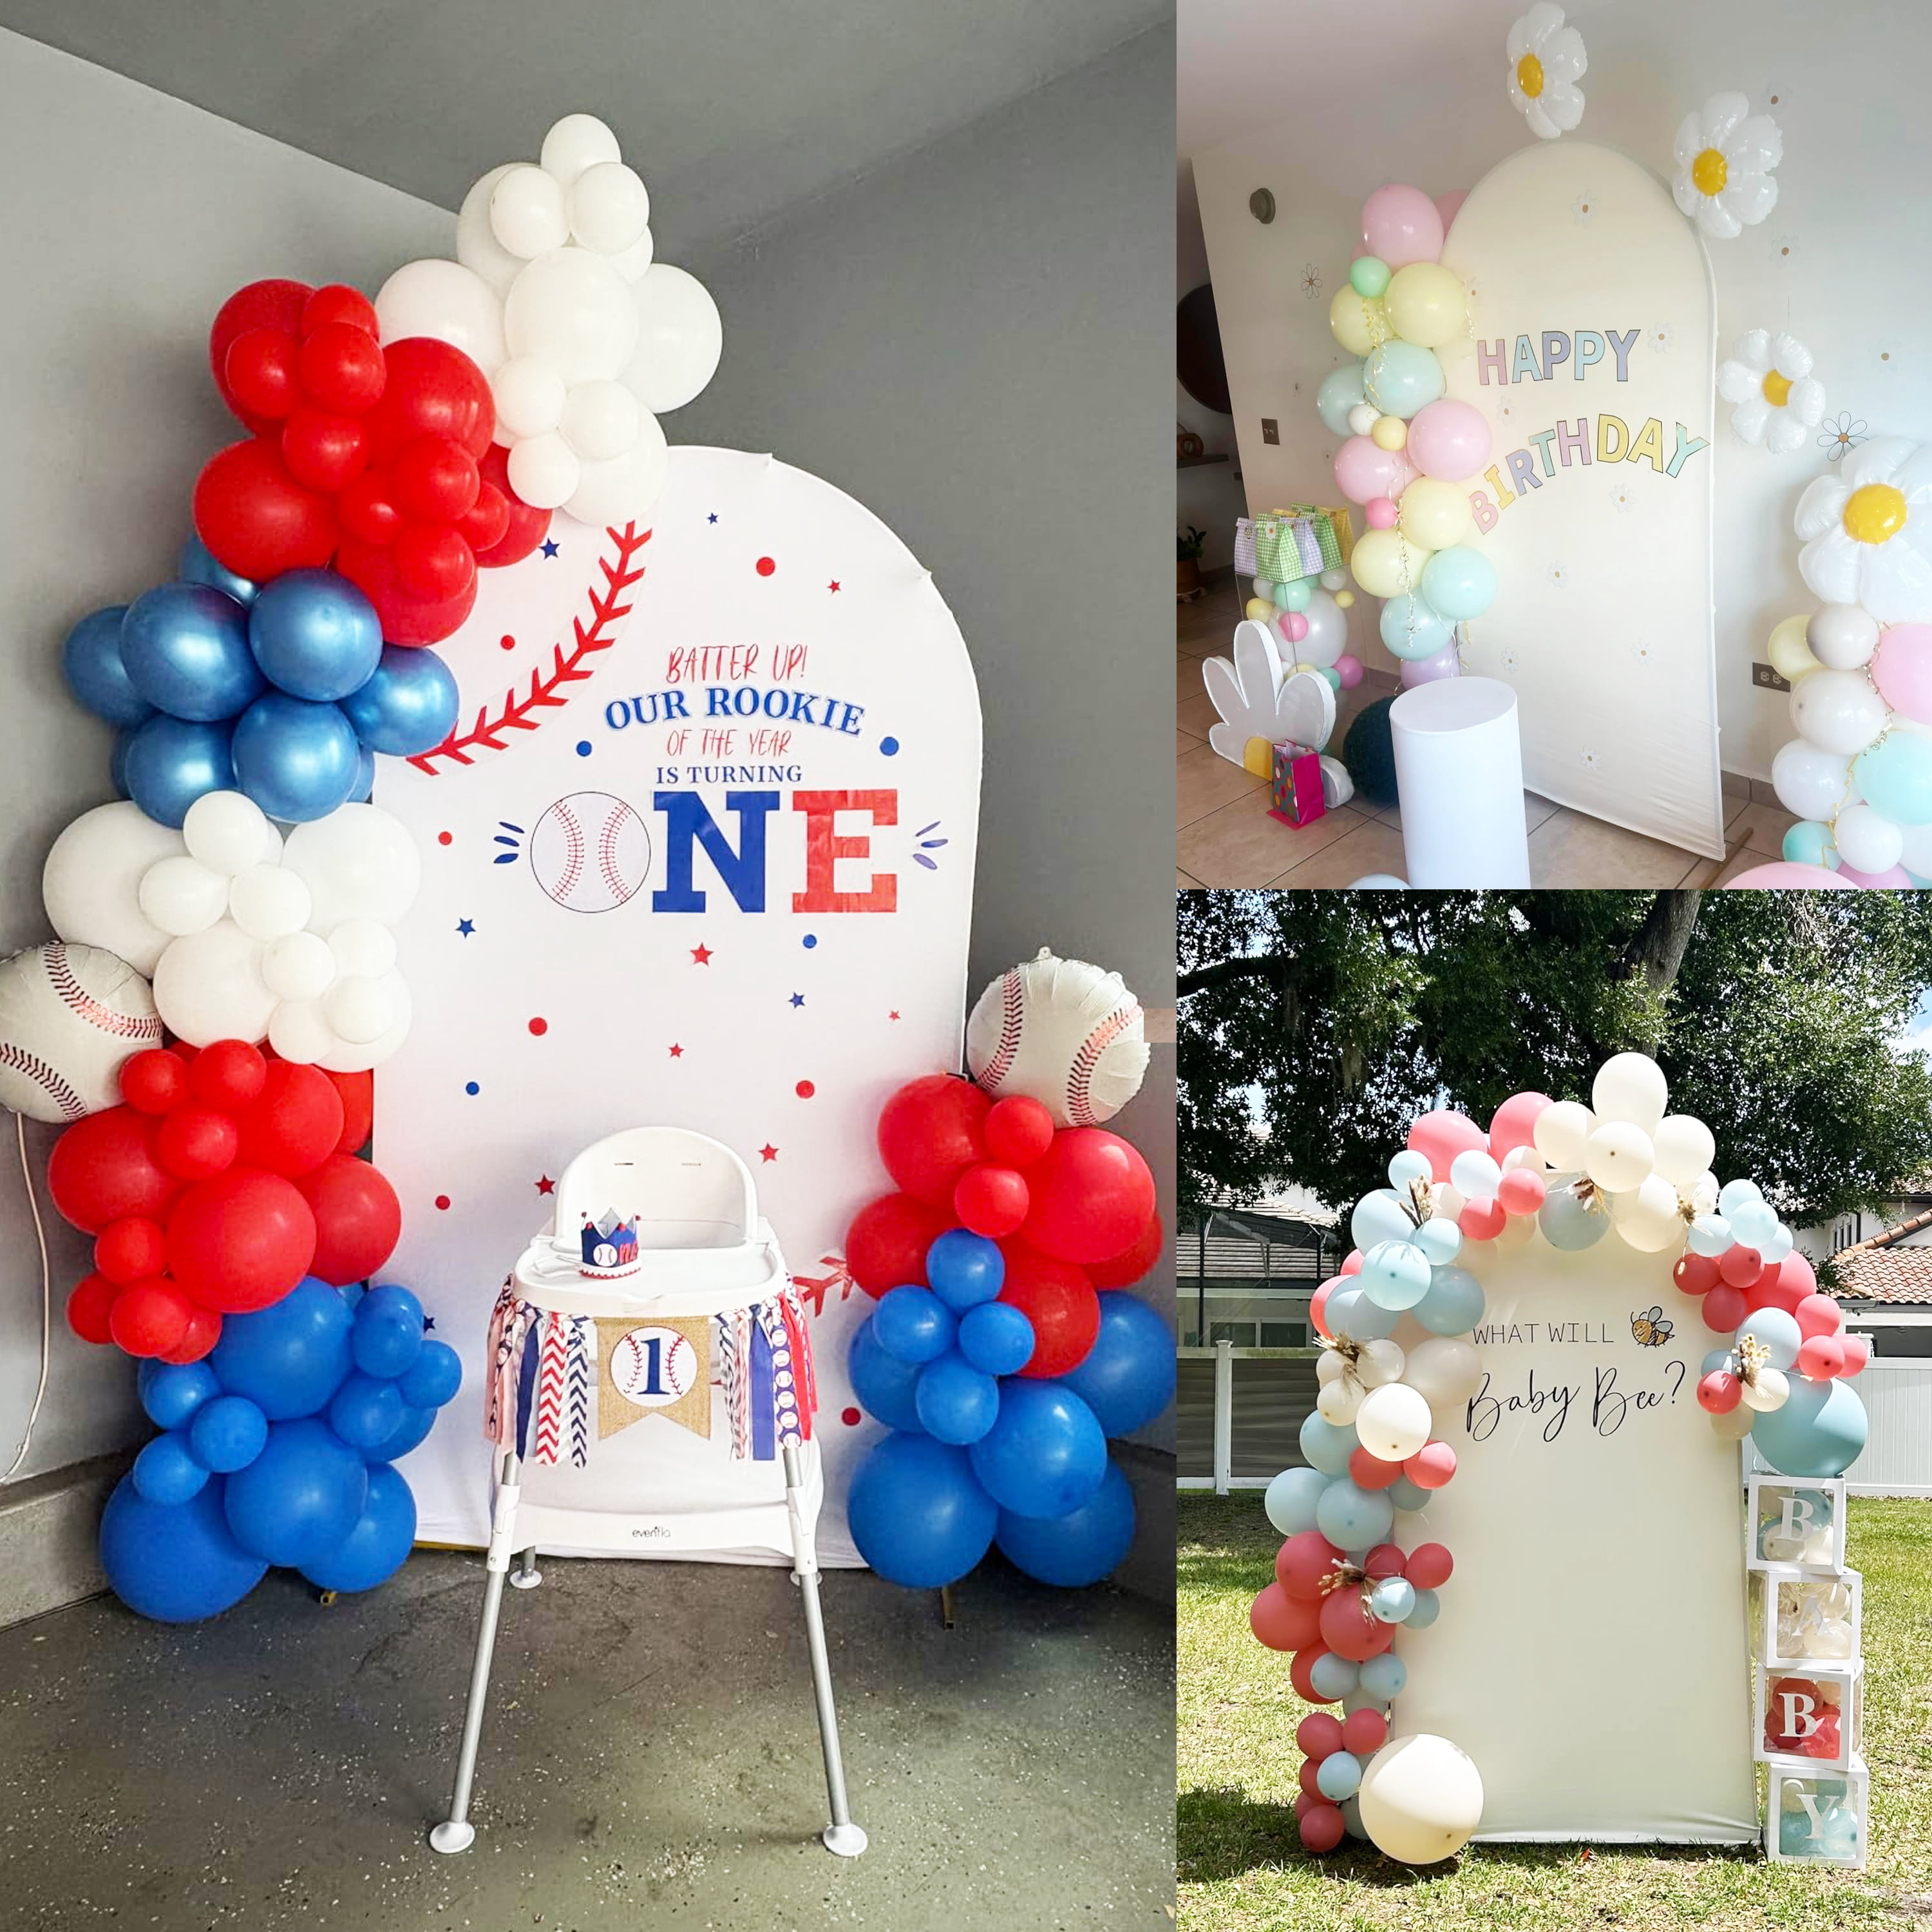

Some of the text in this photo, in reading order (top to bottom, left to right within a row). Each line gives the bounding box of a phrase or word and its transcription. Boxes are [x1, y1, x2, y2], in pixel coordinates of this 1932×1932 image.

[1477, 329, 1641, 386] HAPPY
[1469, 413, 1710, 535] BIRTHDAY
[666, 644, 807, 684] BATTER UP!
[605, 687, 866, 735] OUR ROOKIE
[667, 729, 791, 759] OF THE YEAR
[656, 765, 802, 784] IS TURNING
[1472, 1322, 1615, 1345] WHAT WILL
[636, 1337, 671, 1395] 1
[1466, 1360, 1686, 1443] Baby Bee?
